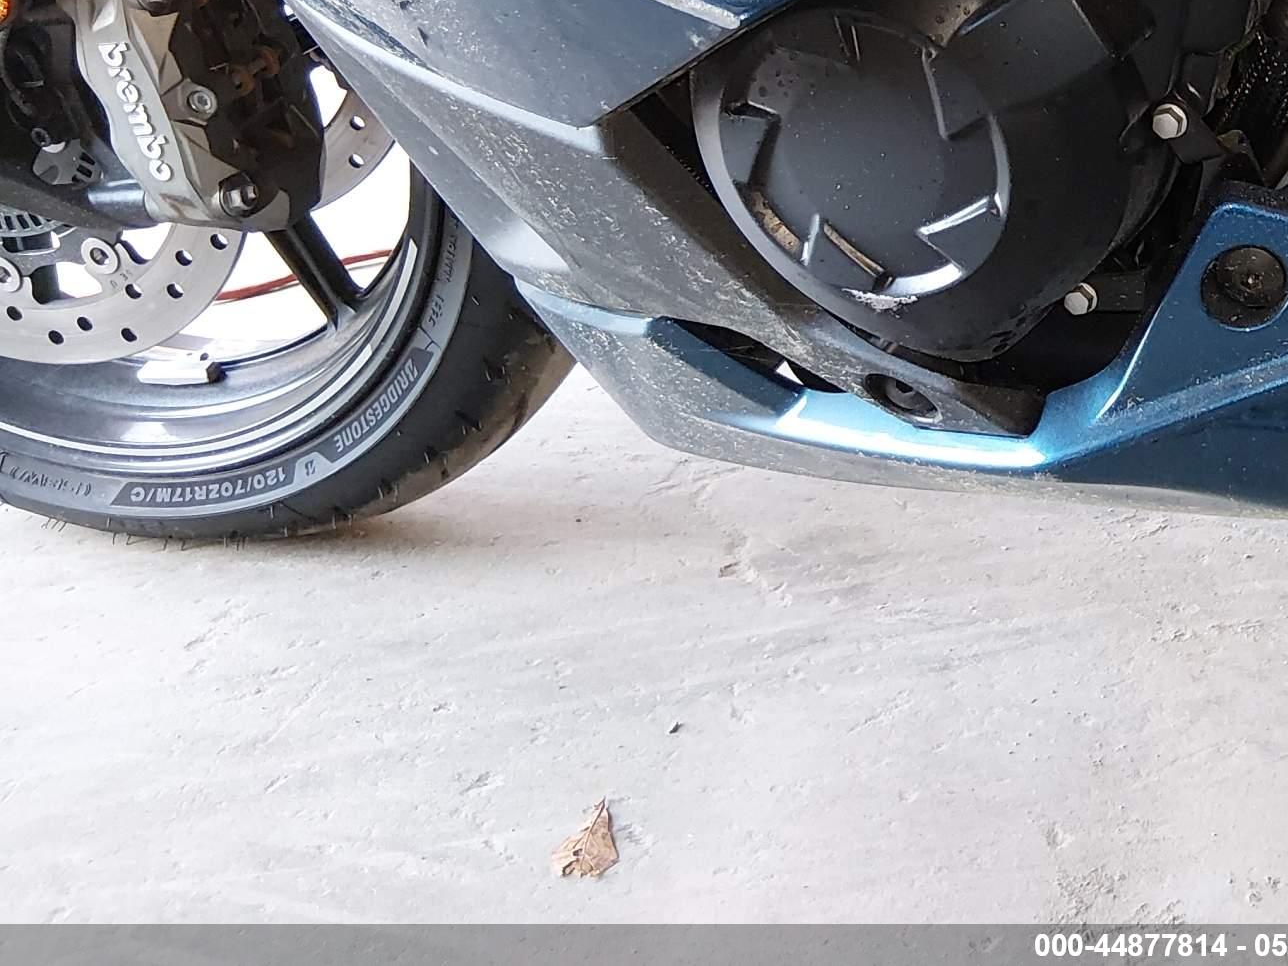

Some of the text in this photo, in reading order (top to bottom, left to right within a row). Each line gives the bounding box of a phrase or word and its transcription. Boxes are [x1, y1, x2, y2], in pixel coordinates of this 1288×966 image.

[96, 41, 173, 182] brembo
[334, 358, 420, 452] BRIDGESTONE
[130, 466, 286, 503] 120/70ZR17M/C
